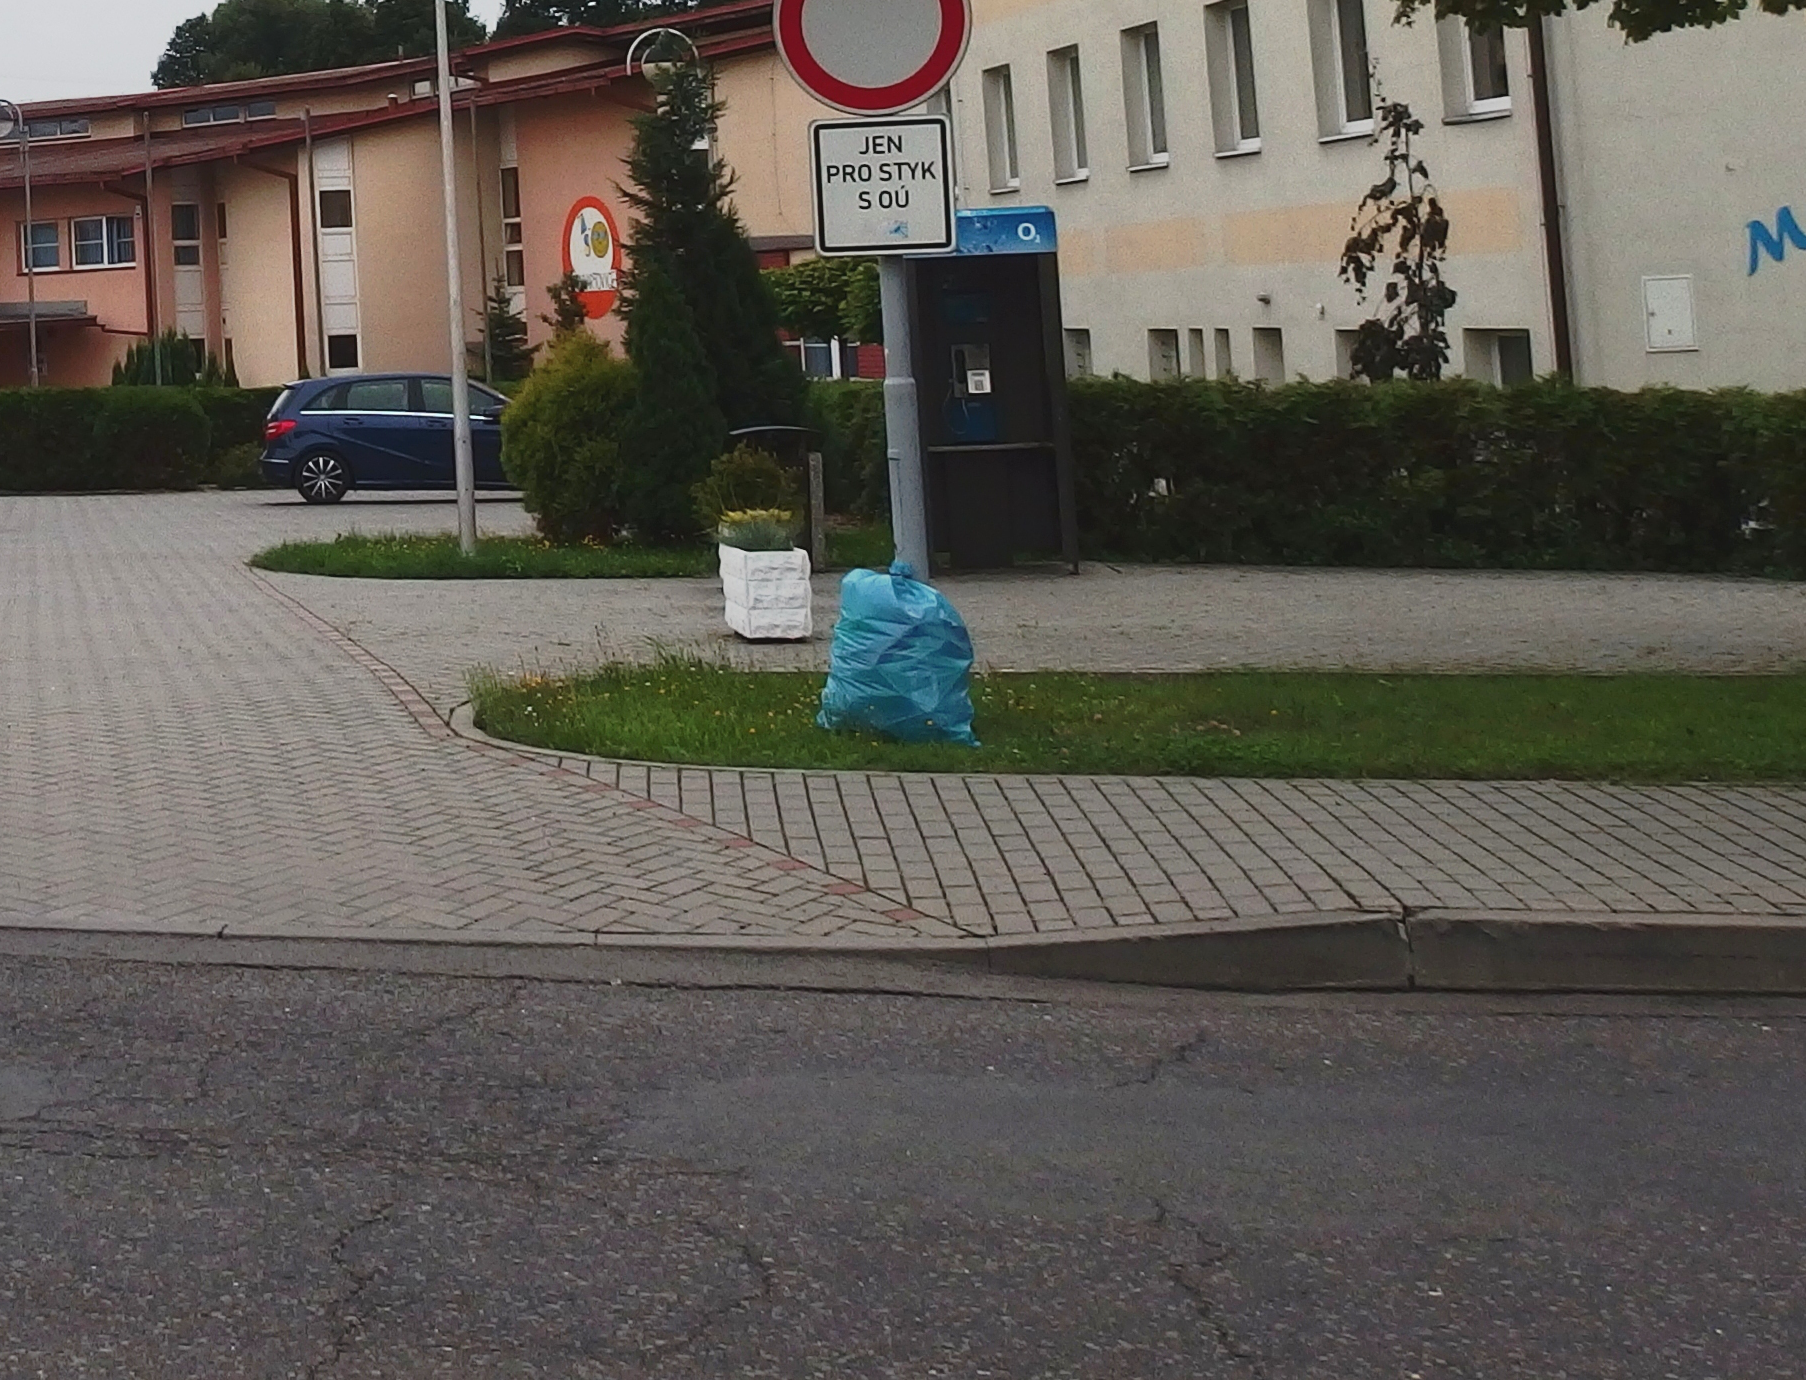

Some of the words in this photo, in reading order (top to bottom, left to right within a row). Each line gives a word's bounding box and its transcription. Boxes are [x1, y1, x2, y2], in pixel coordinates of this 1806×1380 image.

[859, 135, 903, 155] JEN
[826, 164, 872, 183] PRO
[879, 161, 937, 182] STYK
[858, 191, 872, 210] S
[878, 185, 910, 209] OÚ
